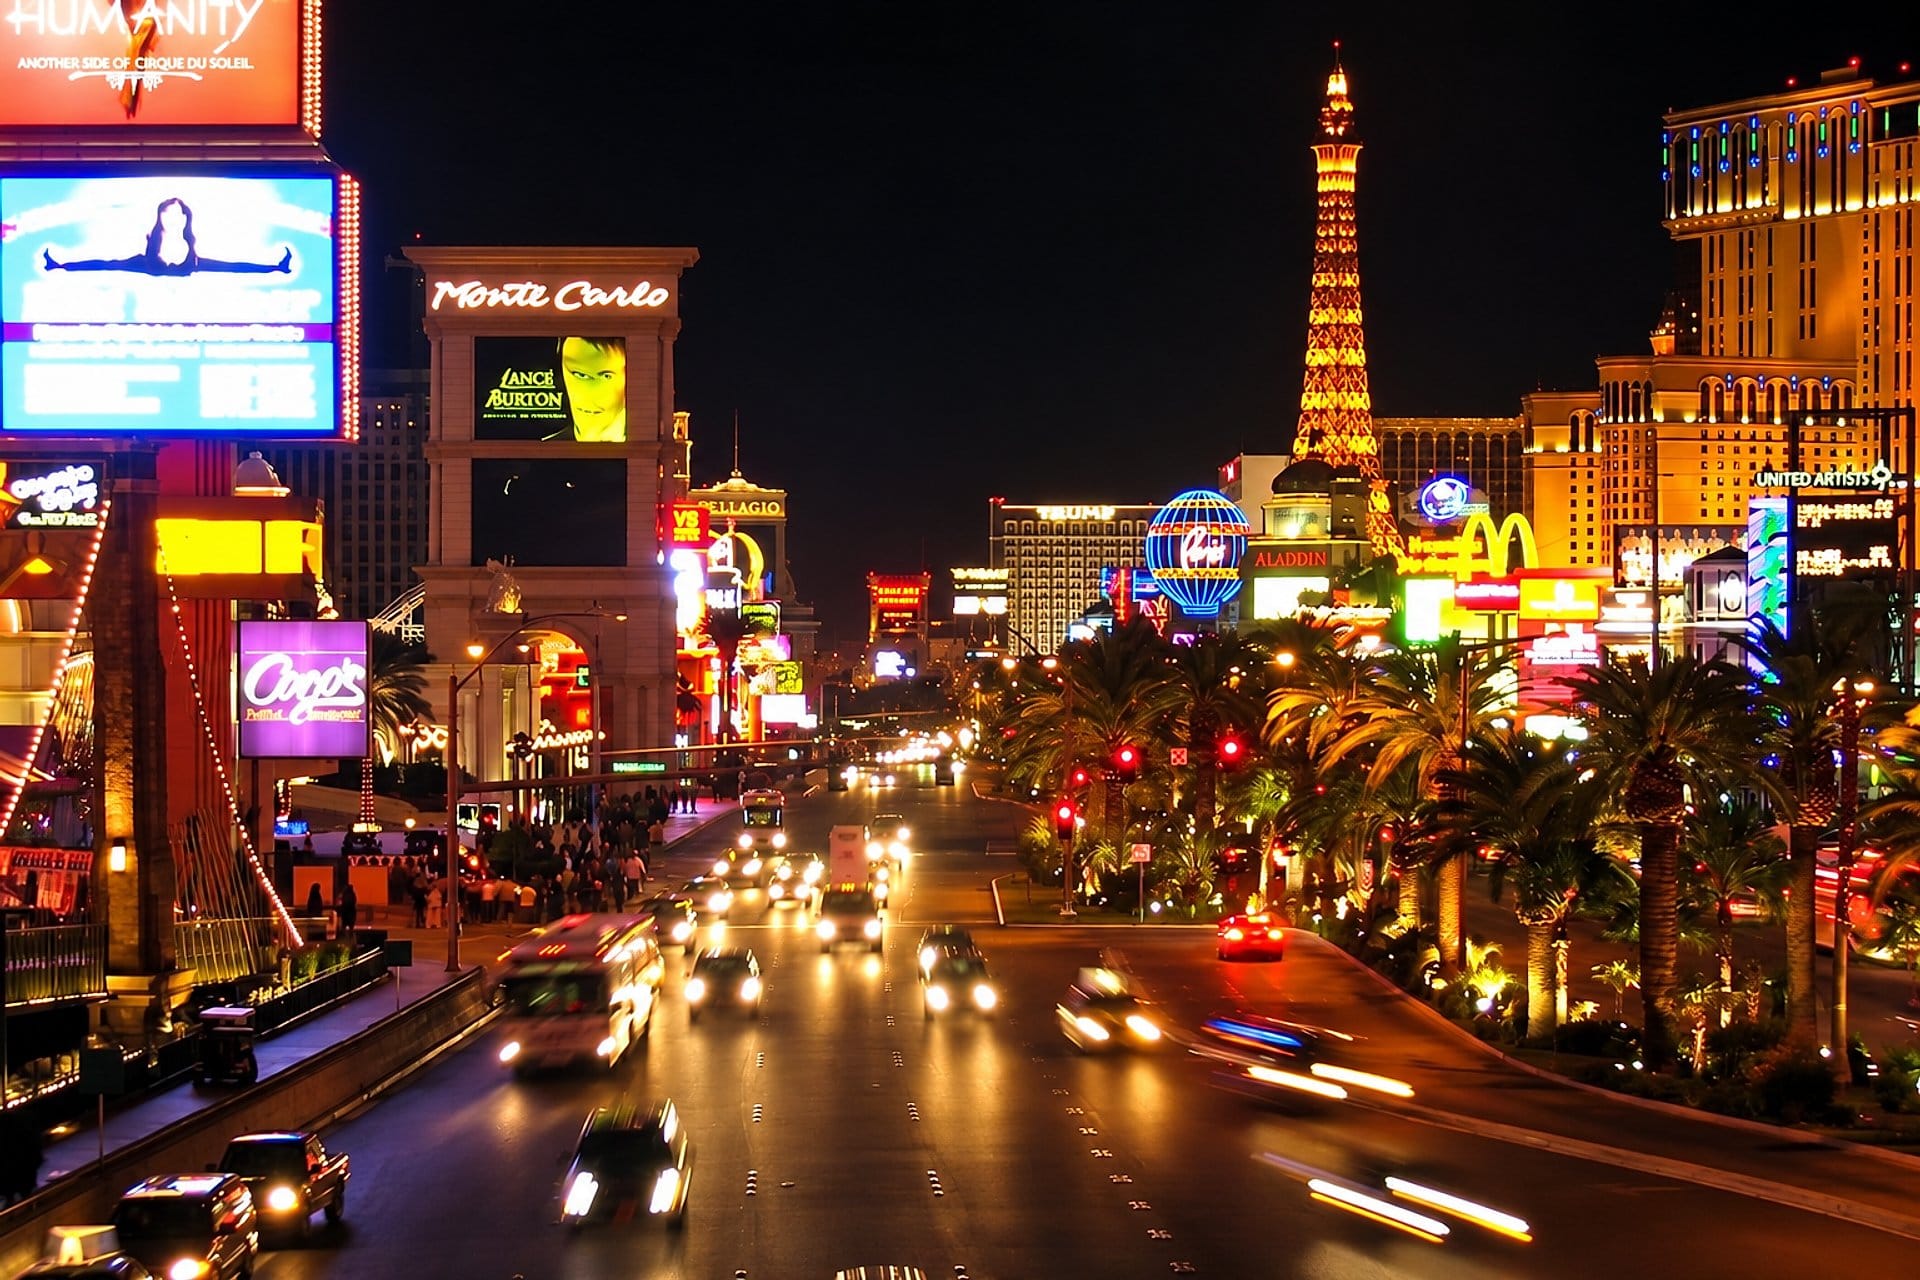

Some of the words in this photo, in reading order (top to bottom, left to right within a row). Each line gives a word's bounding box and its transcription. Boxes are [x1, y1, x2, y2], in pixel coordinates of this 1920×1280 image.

[17, 56, 81, 70] ANOTHER
[82, 56, 110, 70] SIDE
[112, 56, 131, 70] OF
[134, 56, 185, 71] CIRQUE
[187, 56, 207, 70] DU
[431, 280, 550, 310] Monte
[553, 280, 669, 311] Carlo
[499, 367, 556, 389] LANCE
[484, 388, 564, 410] BURTON
[1756, 471, 1812, 487] UNITED
[1813, 471, 1870, 487] ARTISTS
[1036, 506, 1115, 520] TRUMP
[1254, 552, 1327, 567] ALADDIN
